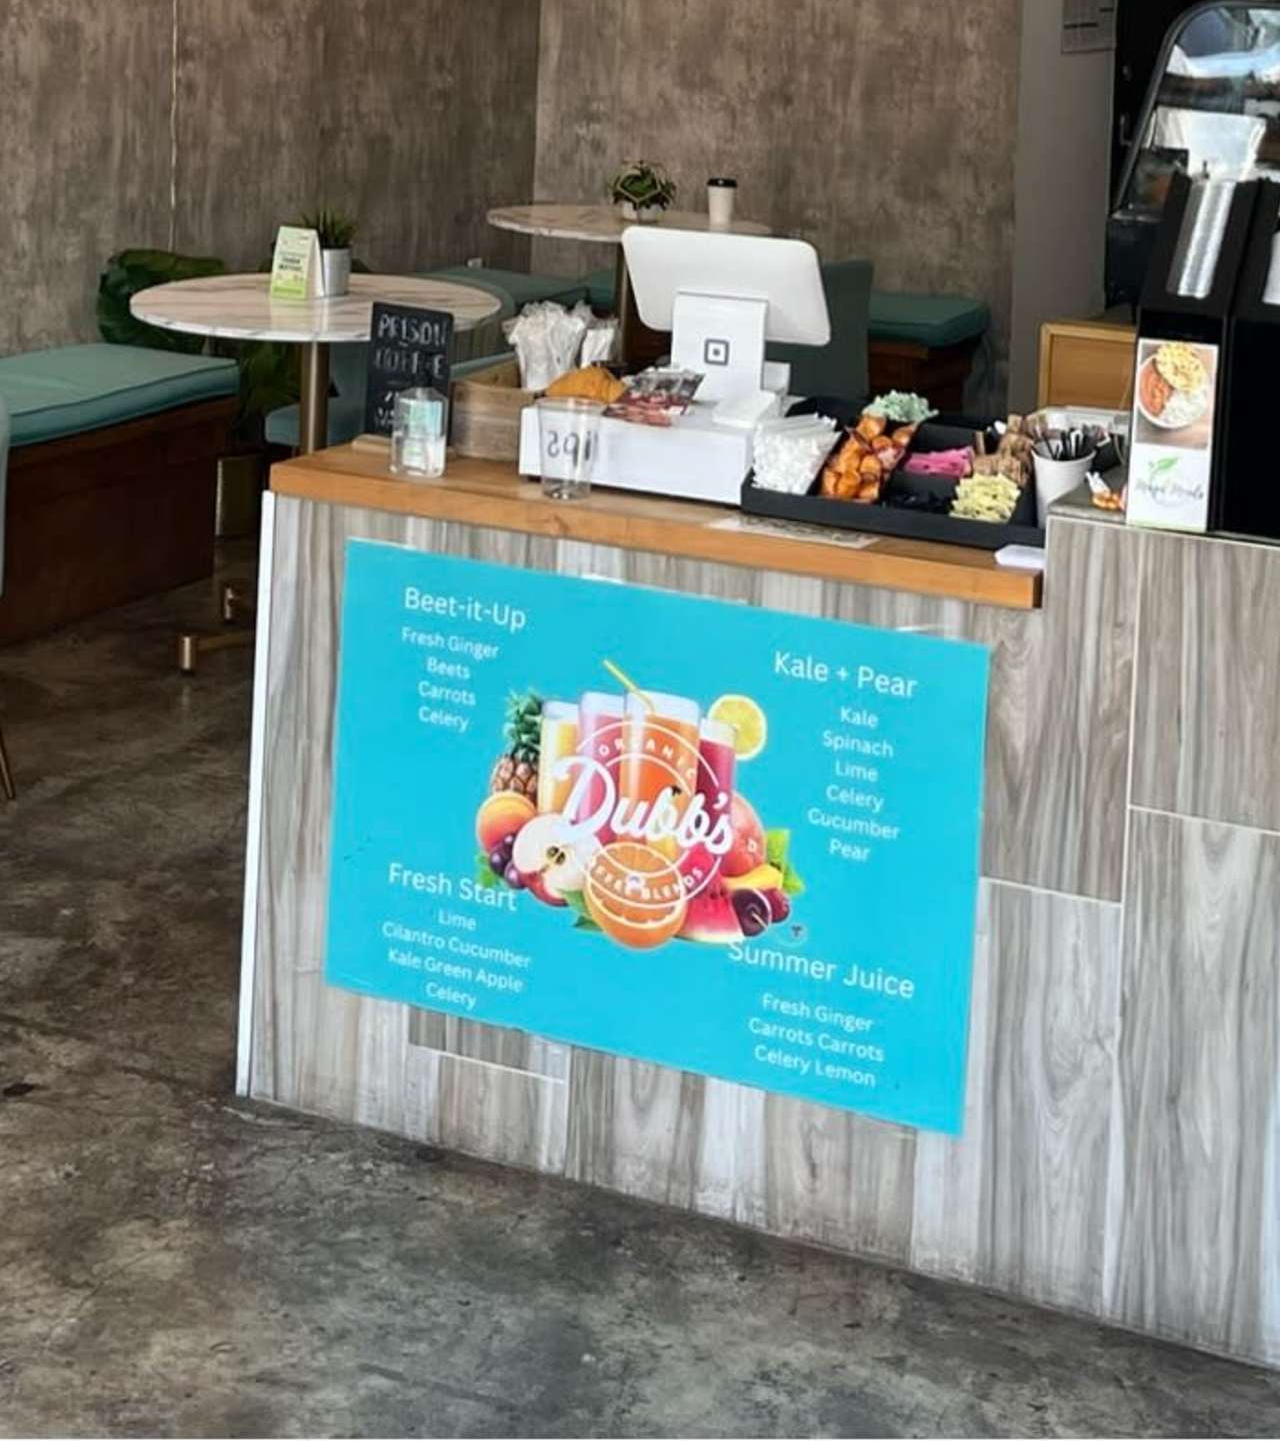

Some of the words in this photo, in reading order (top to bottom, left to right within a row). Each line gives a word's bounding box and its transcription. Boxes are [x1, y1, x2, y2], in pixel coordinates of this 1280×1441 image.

[404, 586, 526, 634] Beet-it-Up
[401, 626, 445, 648] Fresh
[448, 635, 500, 661] Ginger
[426, 655, 471, 680] Beets
[773, 650, 829, 682] Kale
[836, 666, 849, 682] +
[857, 665, 918, 698] Pear
[418, 680, 477, 706] Carrots
[418, 705, 470, 734] Celery
[840, 706, 879, 728] Kale
[598, 738, 697, 779] ORANIC
[822, 729, 894, 759] Spinach
[835, 759, 879, 782] Lime
[551, 754, 733, 855] Dubb's
[826, 784, 885, 813] Celery
[808, 807, 900, 840] Cucumber
[829, 838, 872, 861] Pear
[388, 862, 452, 897] Fresh
[458, 877, 518, 912] Start
[437, 910, 477, 931] Lime
[381, 920, 445, 949] Cilantro
[447, 936, 532, 969] Cucumber
[387, 947, 422, 969] Kale
[424, 956, 473, 980] Green
[475, 968, 524, 992] Apple
[728, 941, 838, 981] Summer
[842, 962, 916, 999] Juice
[425, 981, 477, 1011] Celery
[761, 992, 811, 1019] Fresh
[814, 1005, 874, 1033] Ginger
[748, 1017, 815, 1046] Carrots
[817, 1033, 886, 1063] Carrots
[754, 1044, 812, 1076] Celery
[815, 1059, 877, 1088] Lemon
